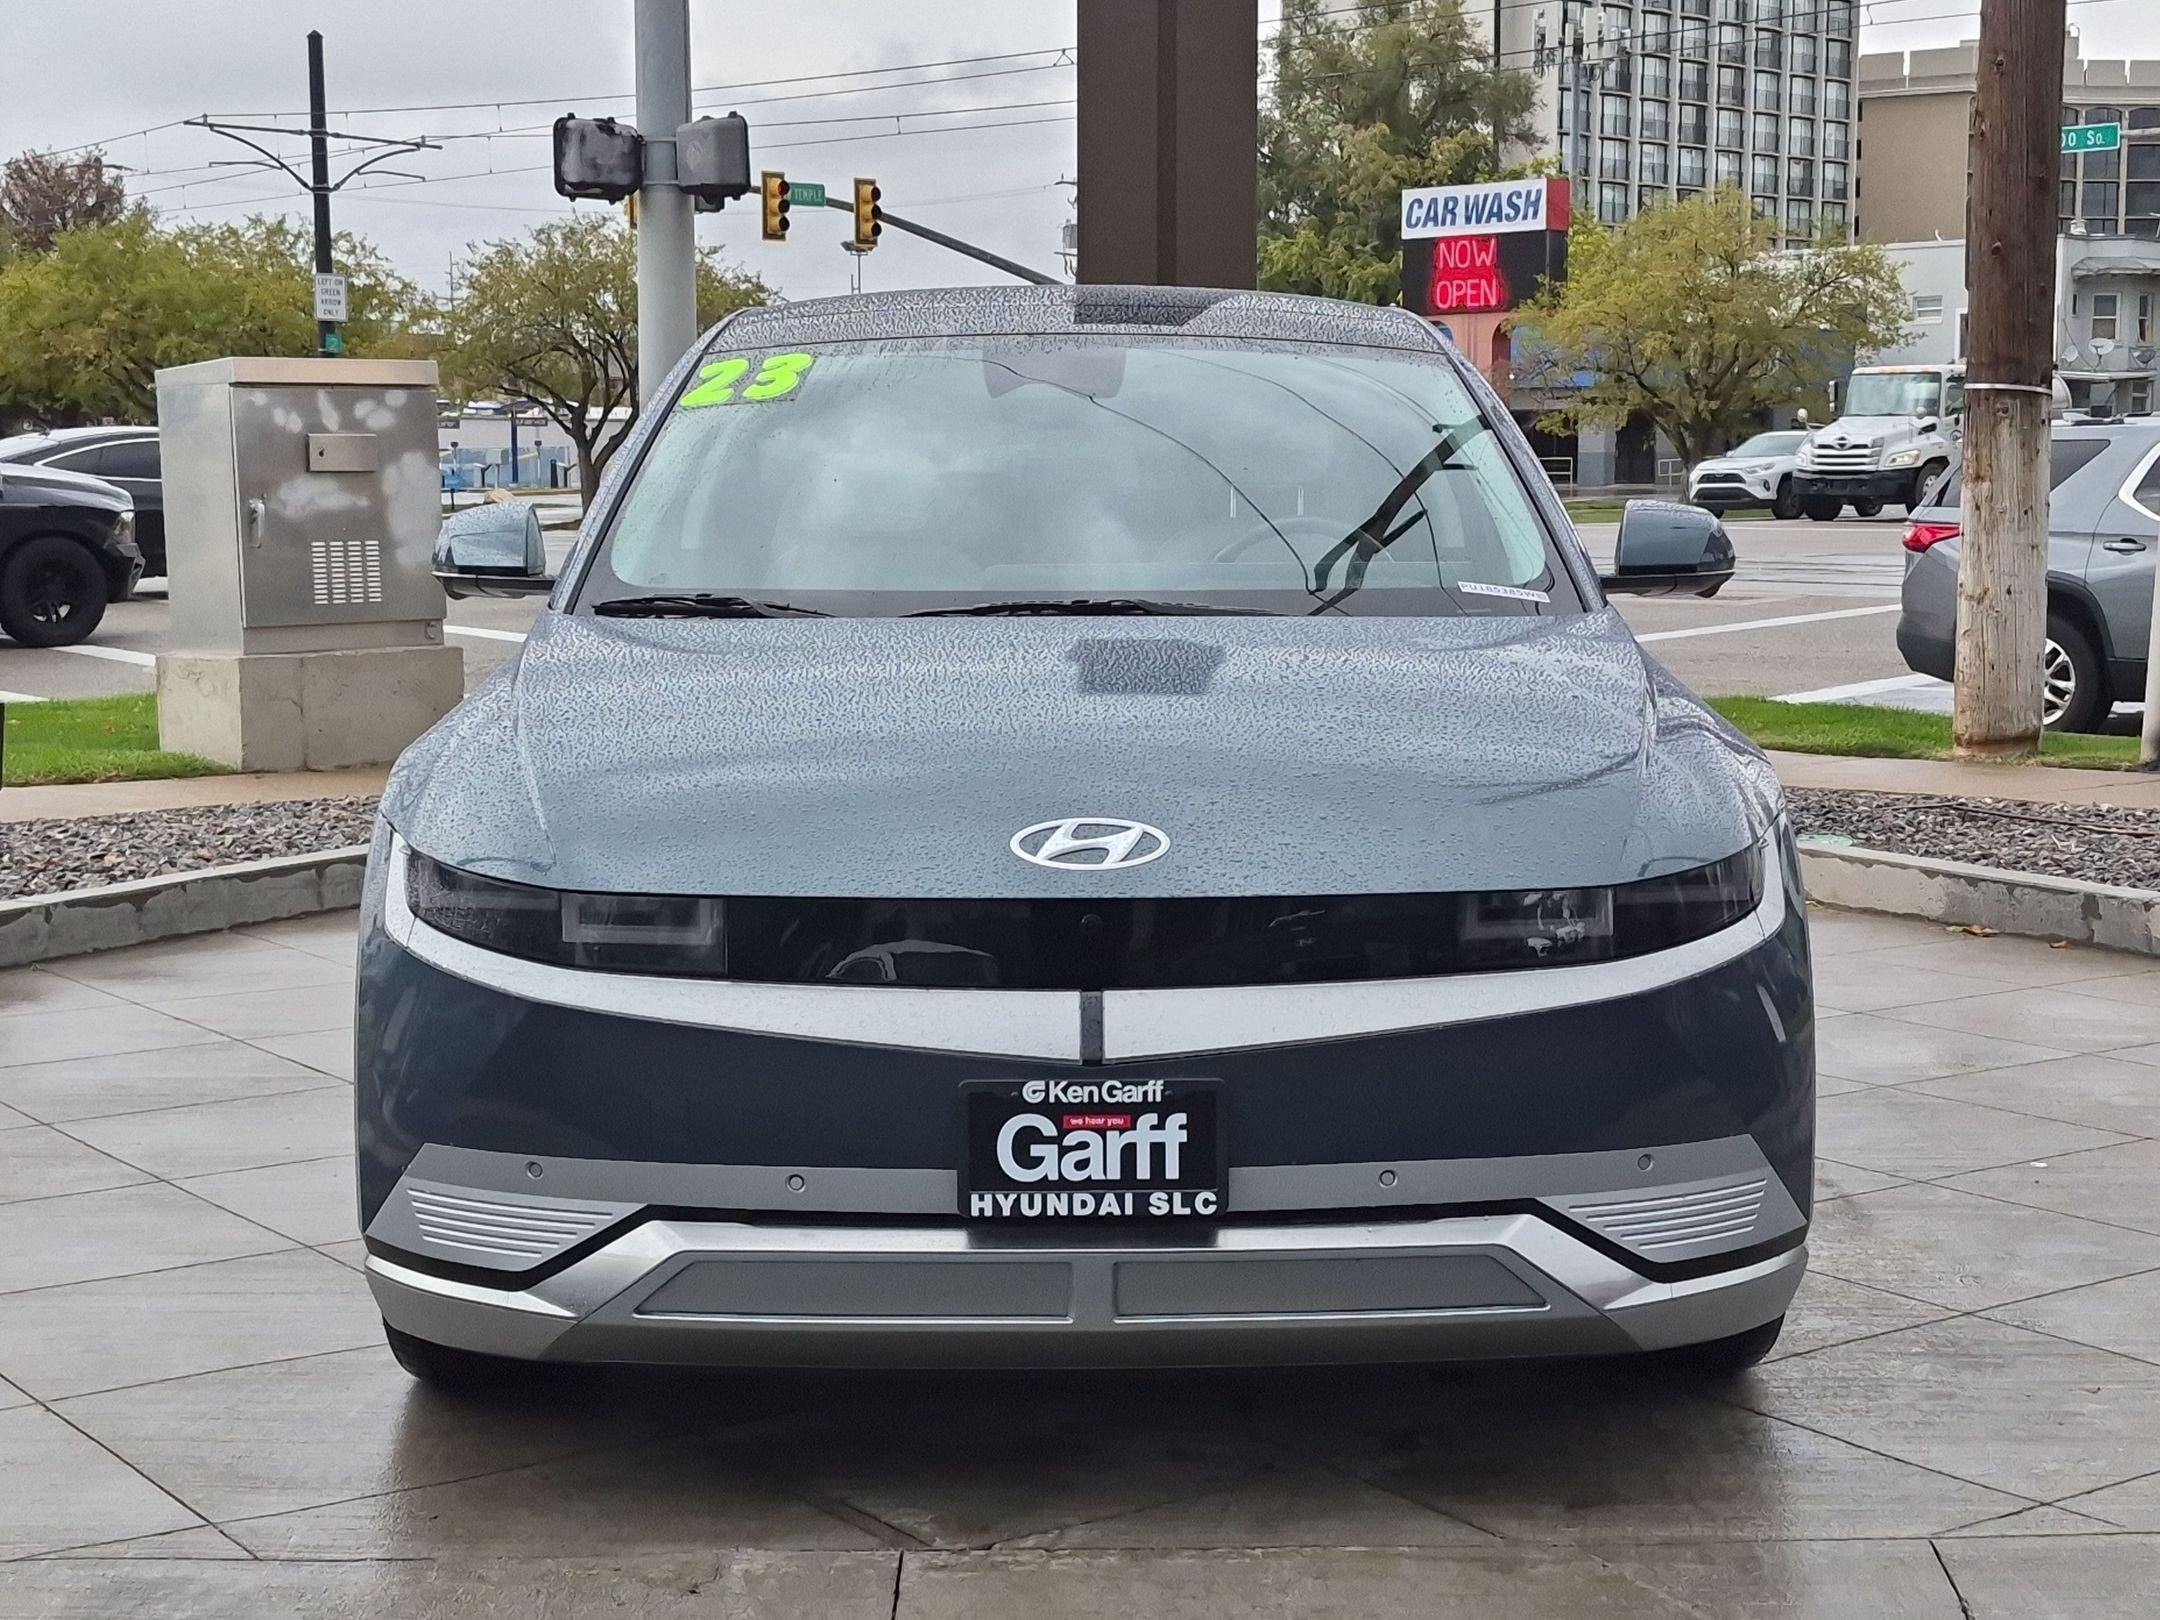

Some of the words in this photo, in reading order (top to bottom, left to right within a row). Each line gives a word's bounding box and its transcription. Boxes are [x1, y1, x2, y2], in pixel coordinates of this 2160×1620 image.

[1405, 196, 1459, 229] CAR
[1464, 188, 1543, 225] WASH
[1439, 238, 1495, 270] NOW
[317, 278, 332, 286] LEFT
[321, 288, 341, 296] GREEN
[1436, 279, 1497, 309] OPEN
[321, 298, 341, 306] ARROW
[679, 353, 814, 407] 23
[1049, 1080, 1099, 1104] Ken
[1101, 1079, 1165, 1104] Garff
[1085, 1116, 1105, 1125] hear
[1107, 1118, 1124, 1127] you
[996, 1112, 1188, 1183] Garff
[970, 1192, 1133, 1217] HYUNDAI
[1148, 1191, 1218, 1216] SLC
